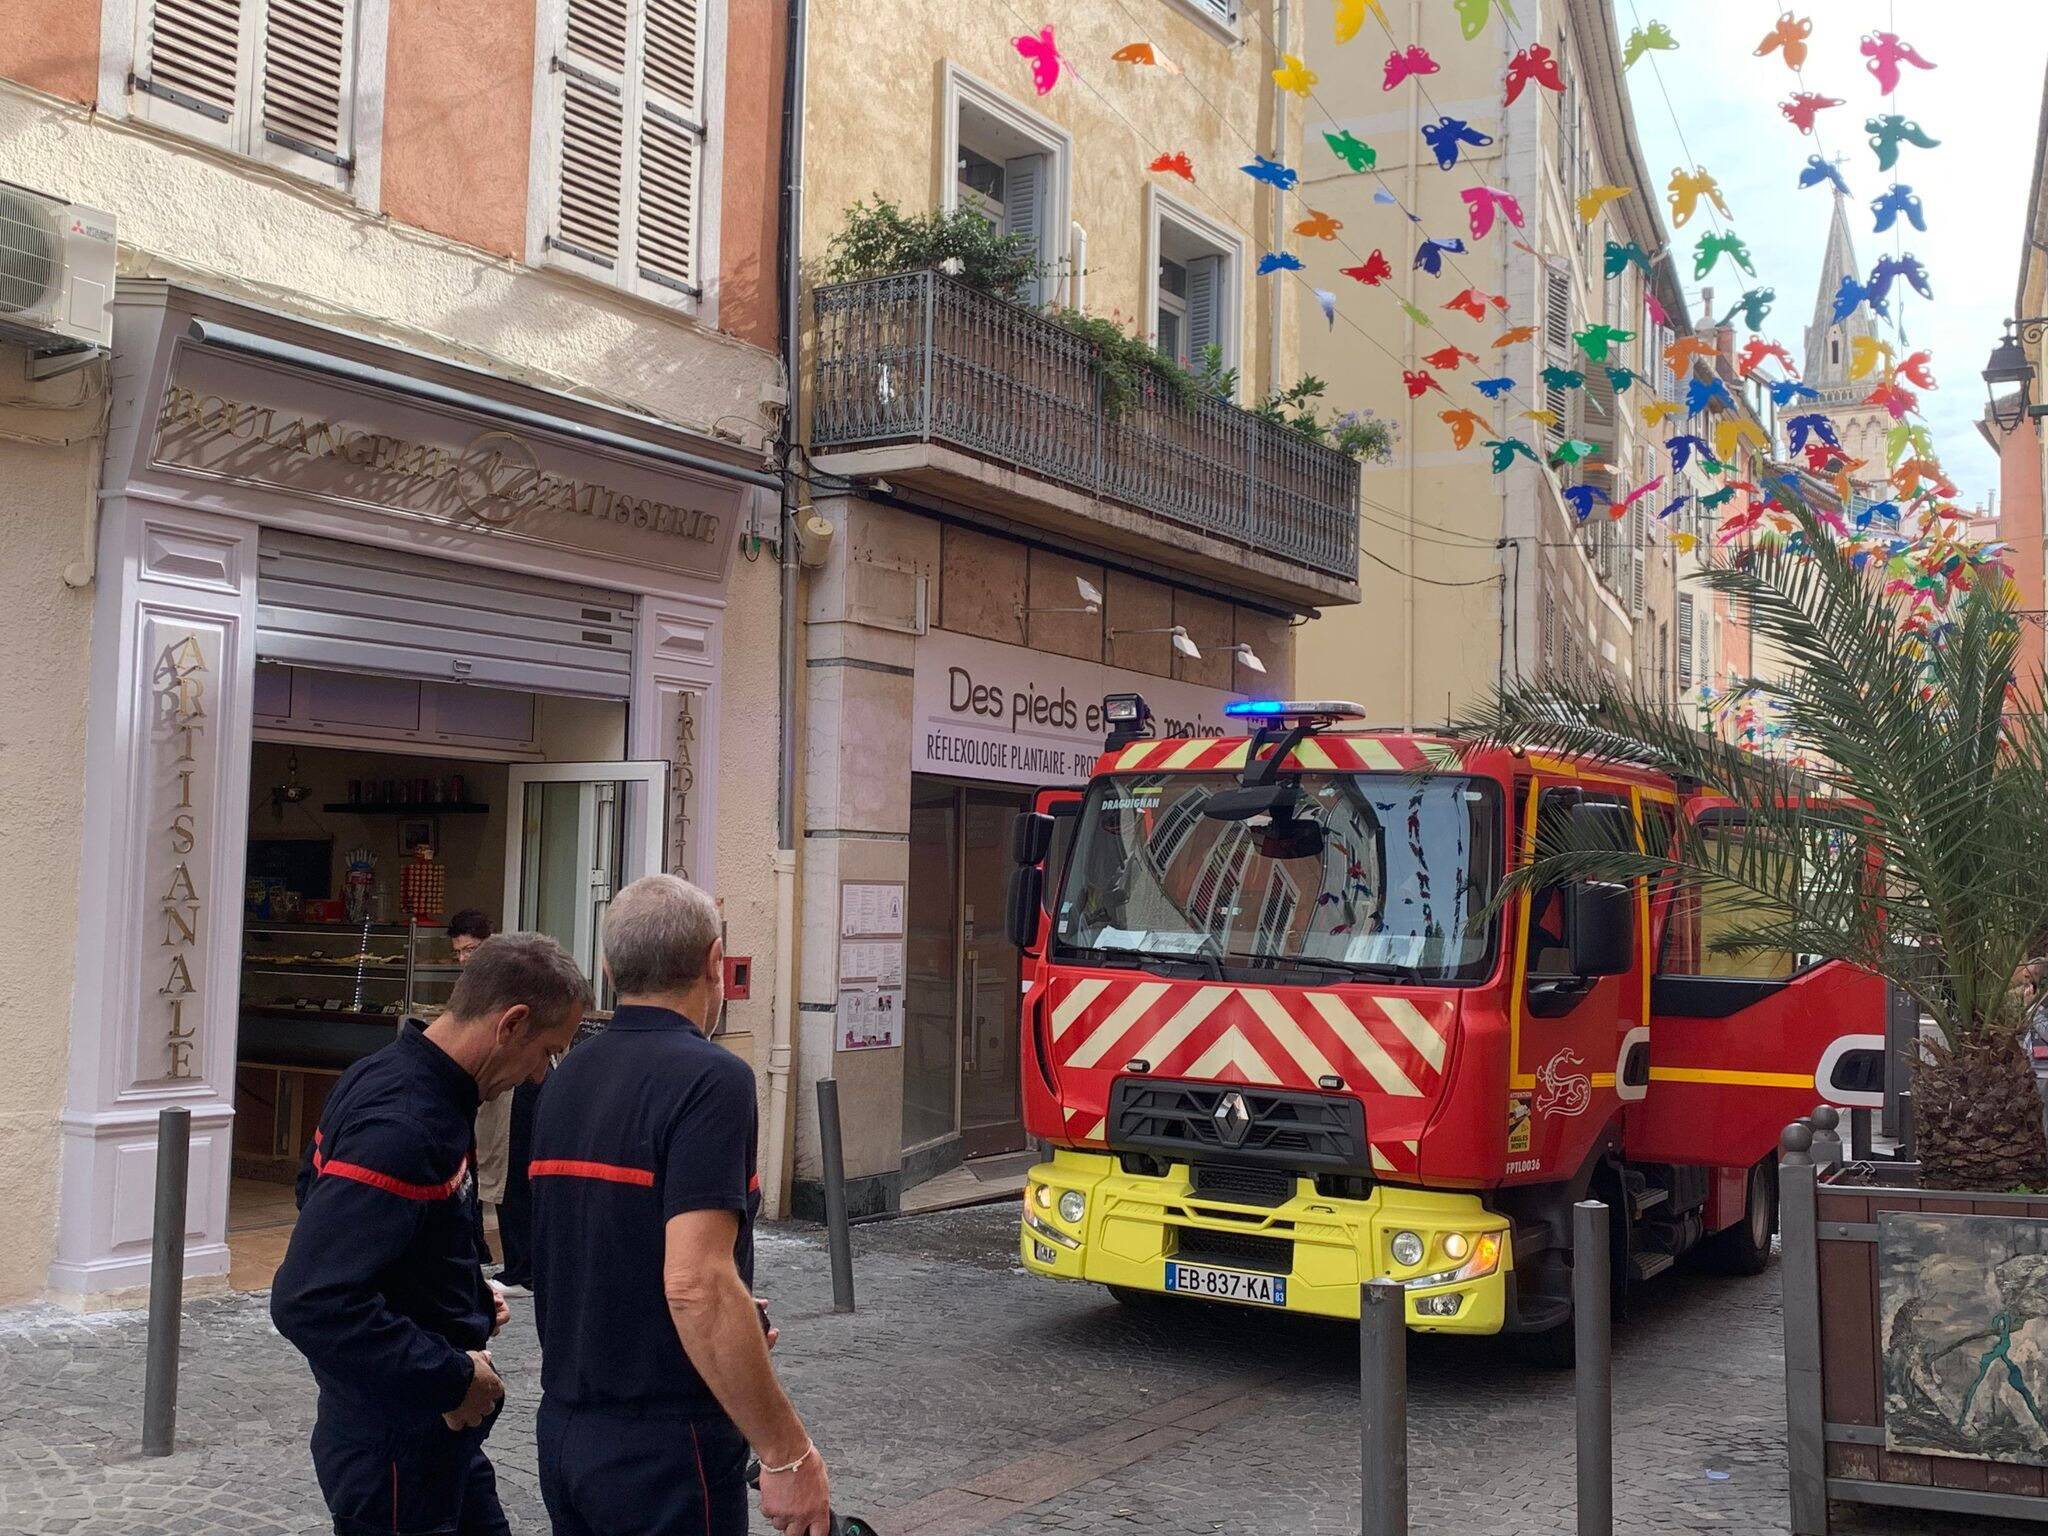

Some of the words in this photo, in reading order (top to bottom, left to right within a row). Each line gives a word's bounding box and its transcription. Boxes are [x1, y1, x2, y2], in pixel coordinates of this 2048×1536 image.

[162, 384, 451, 479] BOULANGERIE
[948, 666, 1004, 718] Des
[1012, 681, 1077, 734] pieds
[927, 728, 1008, 769] RÉFLEXOLOGIE
[1010, 745, 1065, 777] PLANTAIRE
[1101, 798, 1160, 811] DRAGUIGNAN
[159, 632, 209, 1081] ARTISANALE
[1506, 1159, 1540, 1174] FPTL0036
[1177, 1267, 1271, 1301] EB-837-KA
[1274, 1291, 1284, 1303] 83
